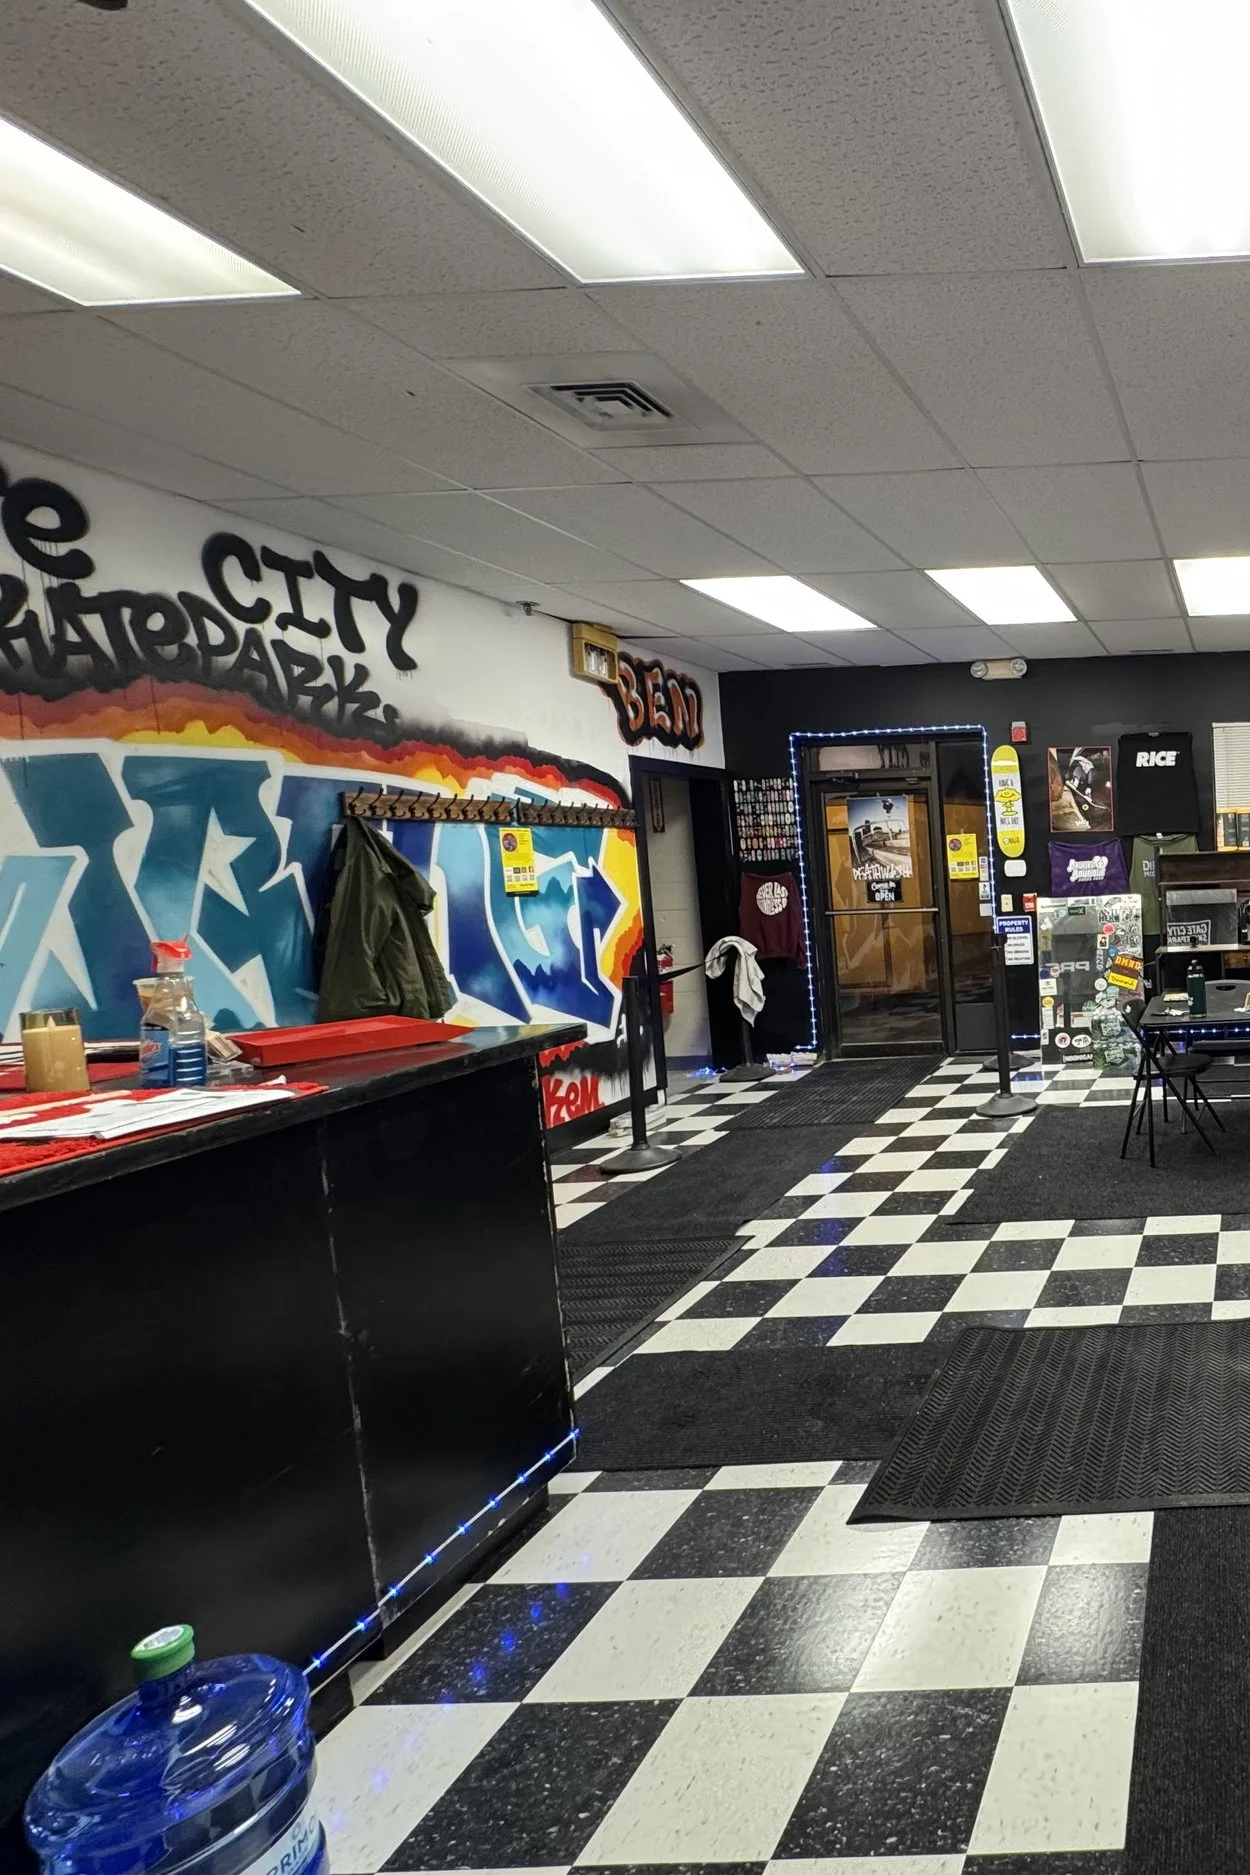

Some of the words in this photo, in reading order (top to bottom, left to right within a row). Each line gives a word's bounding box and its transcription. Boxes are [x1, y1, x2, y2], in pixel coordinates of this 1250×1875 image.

[201, 532, 418, 672] CITY
[1135, 750, 1177, 768] RICE
[875, 892, 895, 901] OPEN
